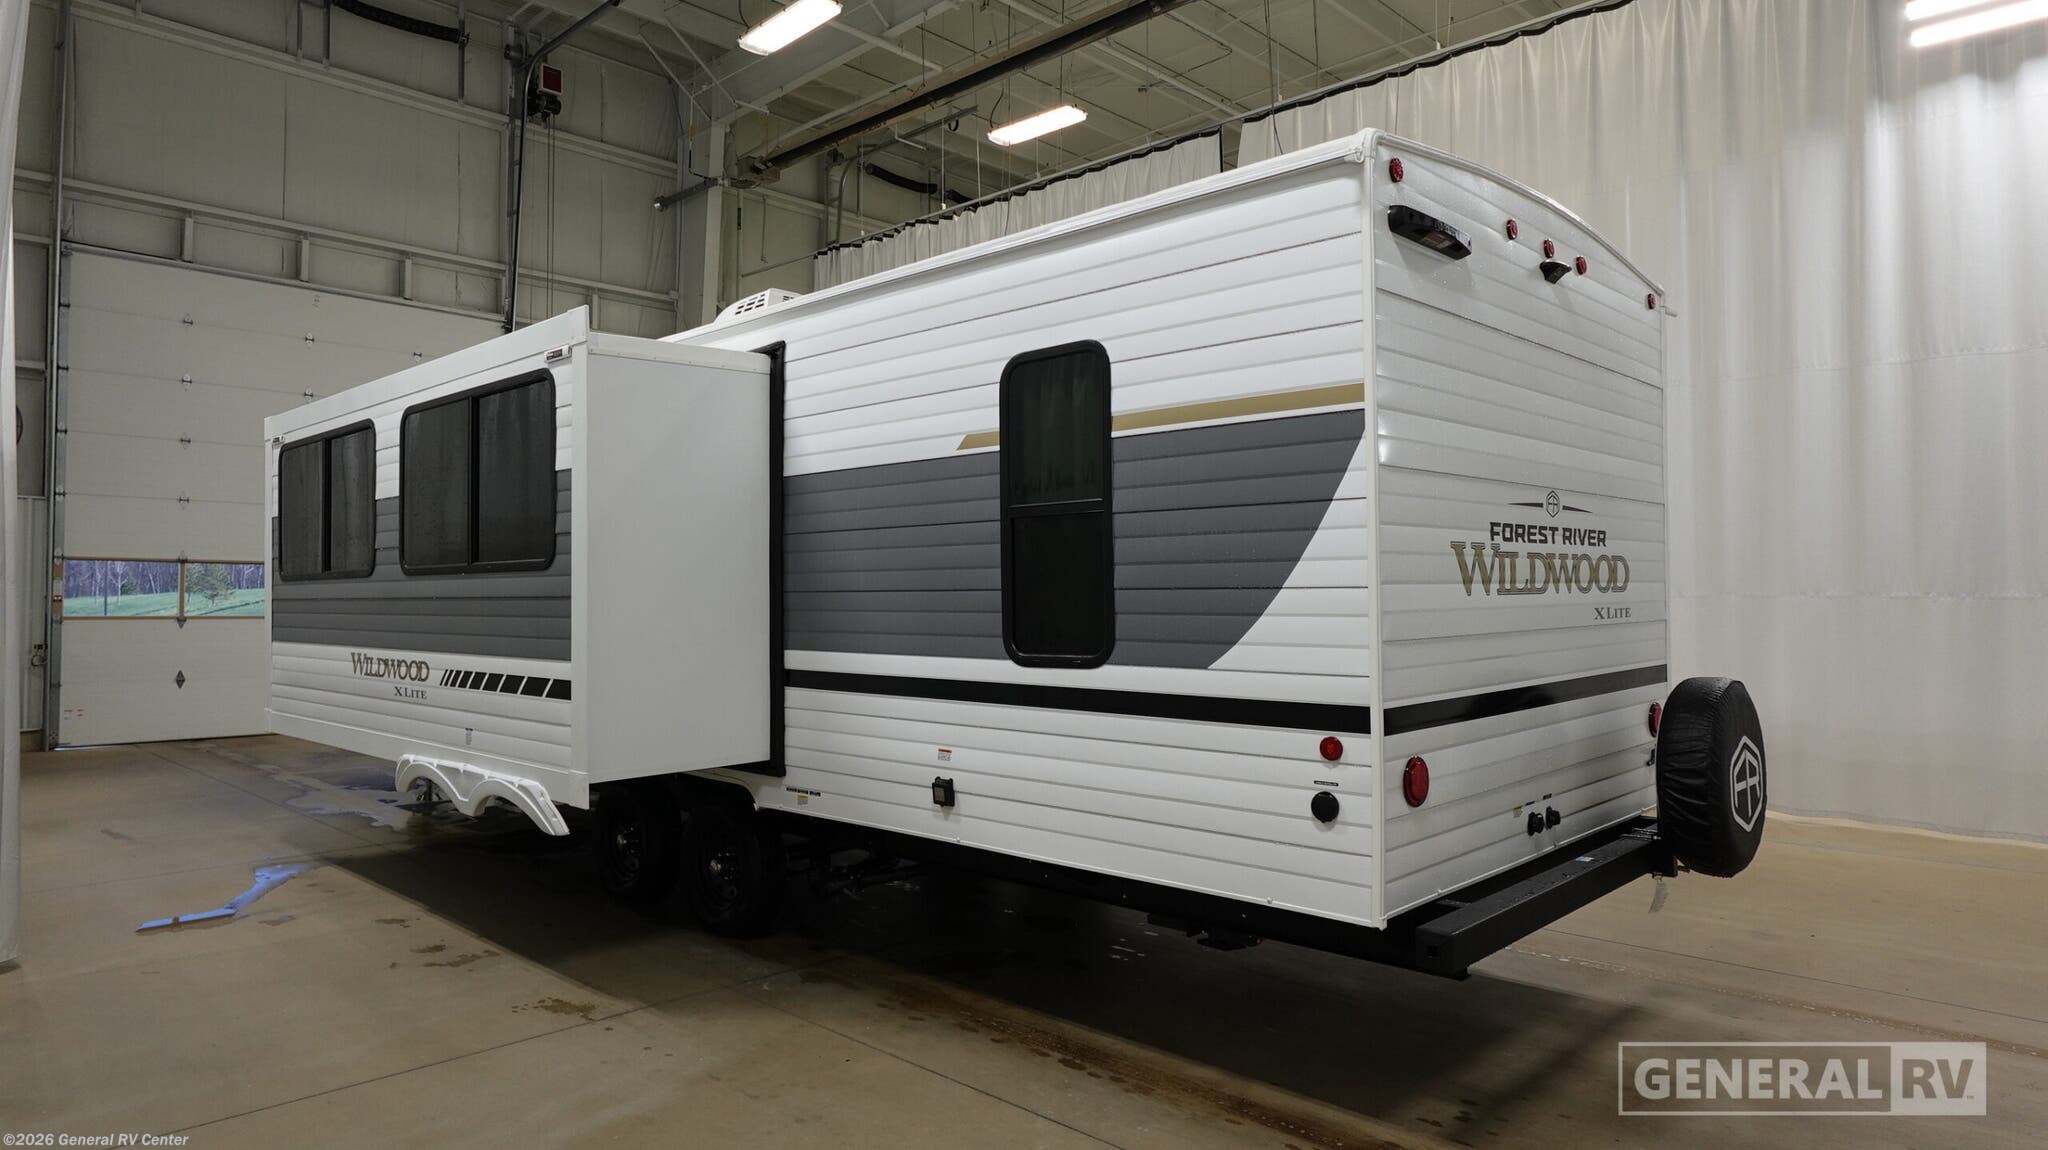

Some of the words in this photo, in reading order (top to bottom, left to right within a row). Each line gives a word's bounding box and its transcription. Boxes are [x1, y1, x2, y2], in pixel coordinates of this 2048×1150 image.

[1489, 522, 1559, 544] FOREST
[1562, 527, 1607, 547] RIVER
[1450, 541, 1630, 596] WILDWOOD
[351, 652, 430, 682] WILDWOOD
